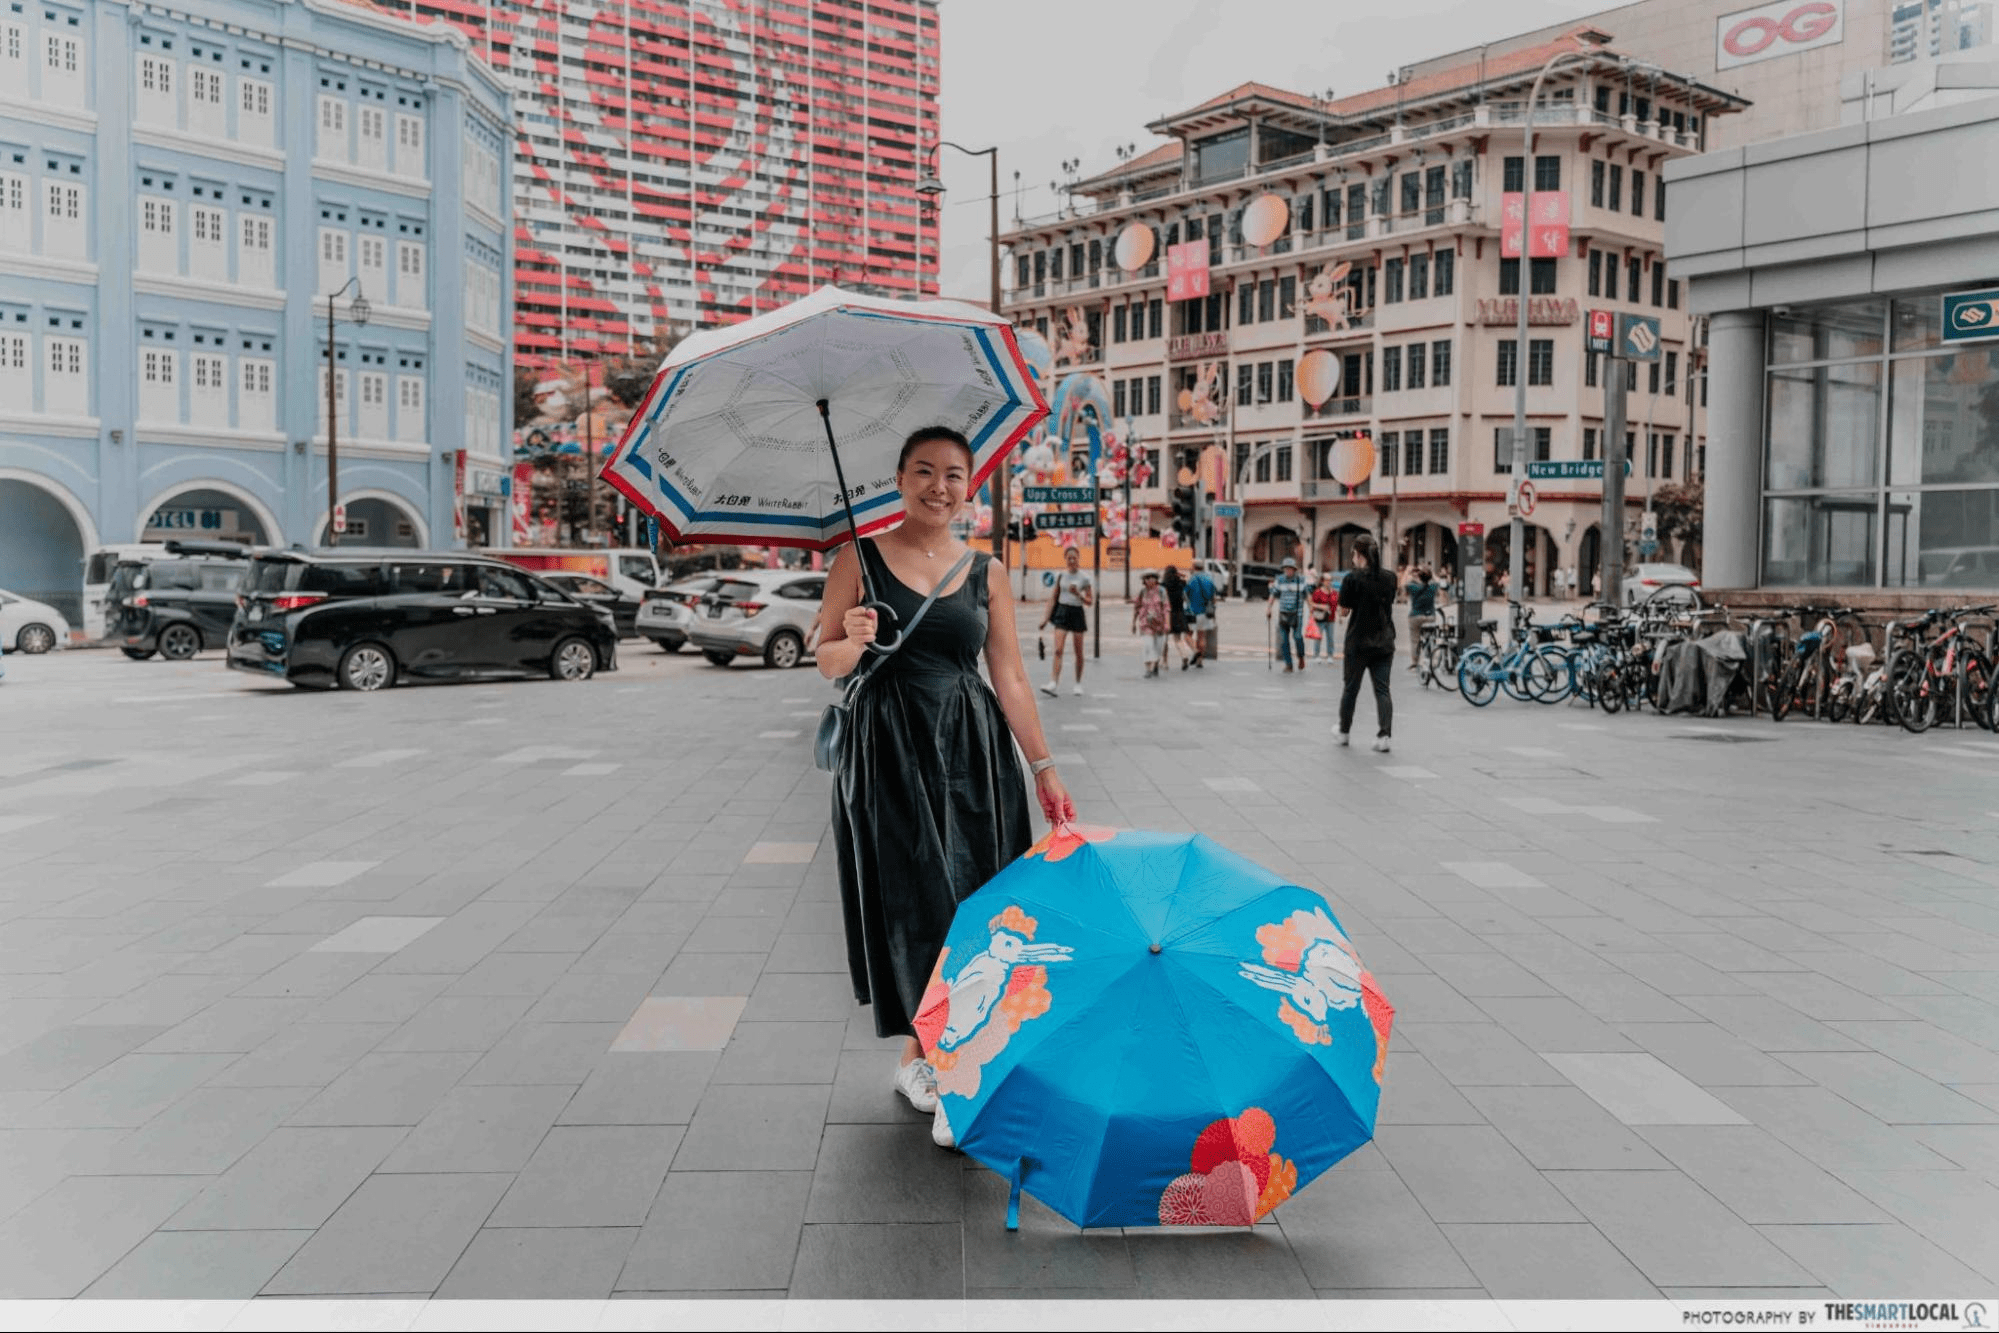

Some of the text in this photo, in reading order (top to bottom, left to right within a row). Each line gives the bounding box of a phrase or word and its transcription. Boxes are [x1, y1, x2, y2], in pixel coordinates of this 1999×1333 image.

[1723, 2, 1838, 57] OG
[1531, 463, 1603, 478] New Bridge
[1027, 488, 1093, 503] Upp Cross St
[149, 511, 195, 529] OTEL
